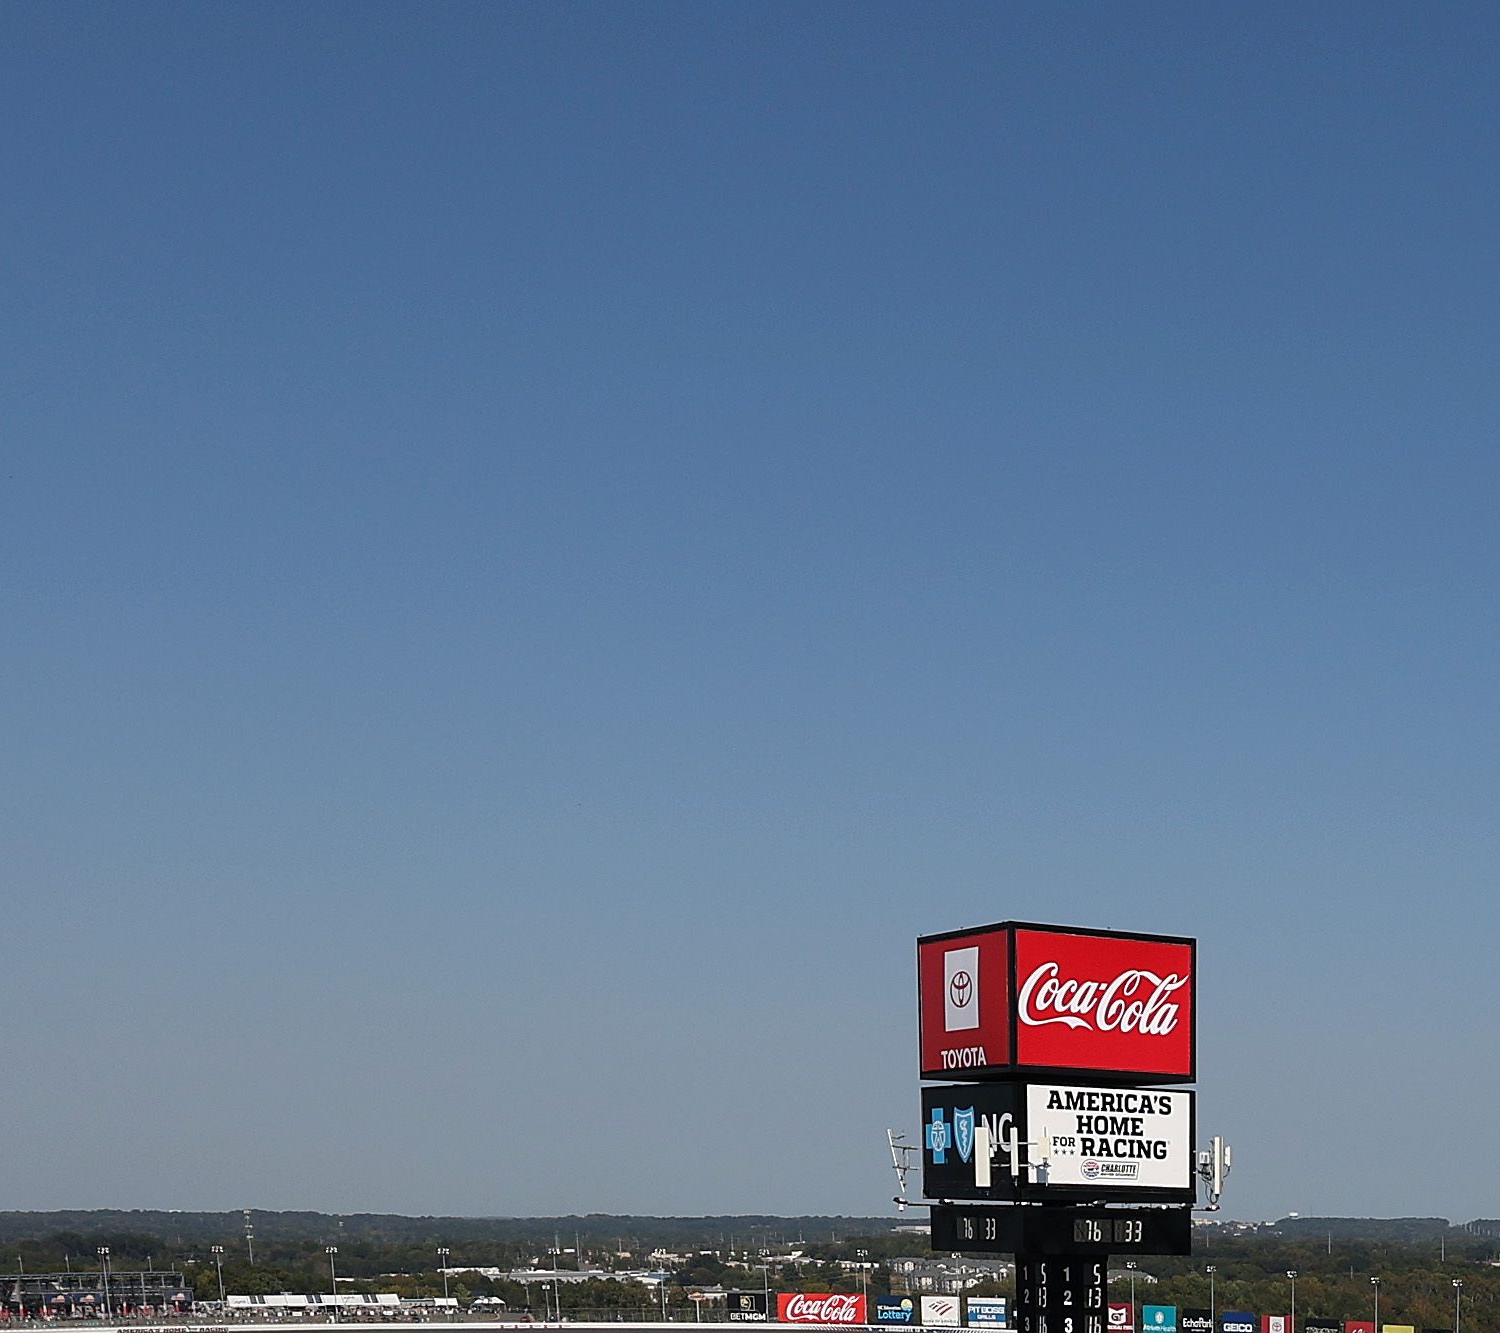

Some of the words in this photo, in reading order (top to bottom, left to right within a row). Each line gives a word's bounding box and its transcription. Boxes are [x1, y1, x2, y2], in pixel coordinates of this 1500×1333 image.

[1018, 962, 1190, 1035] Coca-Cola
[941, 1046, 987, 1069] TOYOTA
[1047, 1090, 1171, 1116] AMERICA'S
[1076, 1115, 1144, 1137] HOME
[1053, 1136, 1076, 1148] FOR
[1080, 1137, 1168, 1160] RACING
[1100, 1163, 1137, 1175] CHARLOTTE
[963, 1218, 973, 1240] 76
[985, 1218, 996, 1240] 33
[1085, 1218, 1102, 1242] 76
[1124, 1220, 1143, 1243] 33
[786, 1294, 860, 1322] Coca-Cola
[1063, 1290, 1073, 1306] 2
[730, 1312, 766, 1322] BETMGM
[877, 1311, 913, 1322] Lottery
[984, 1306, 1005, 1315] BOSS
[1064, 1318, 1073, 1333] 3
[1223, 1322, 1253, 1333] GEICO
